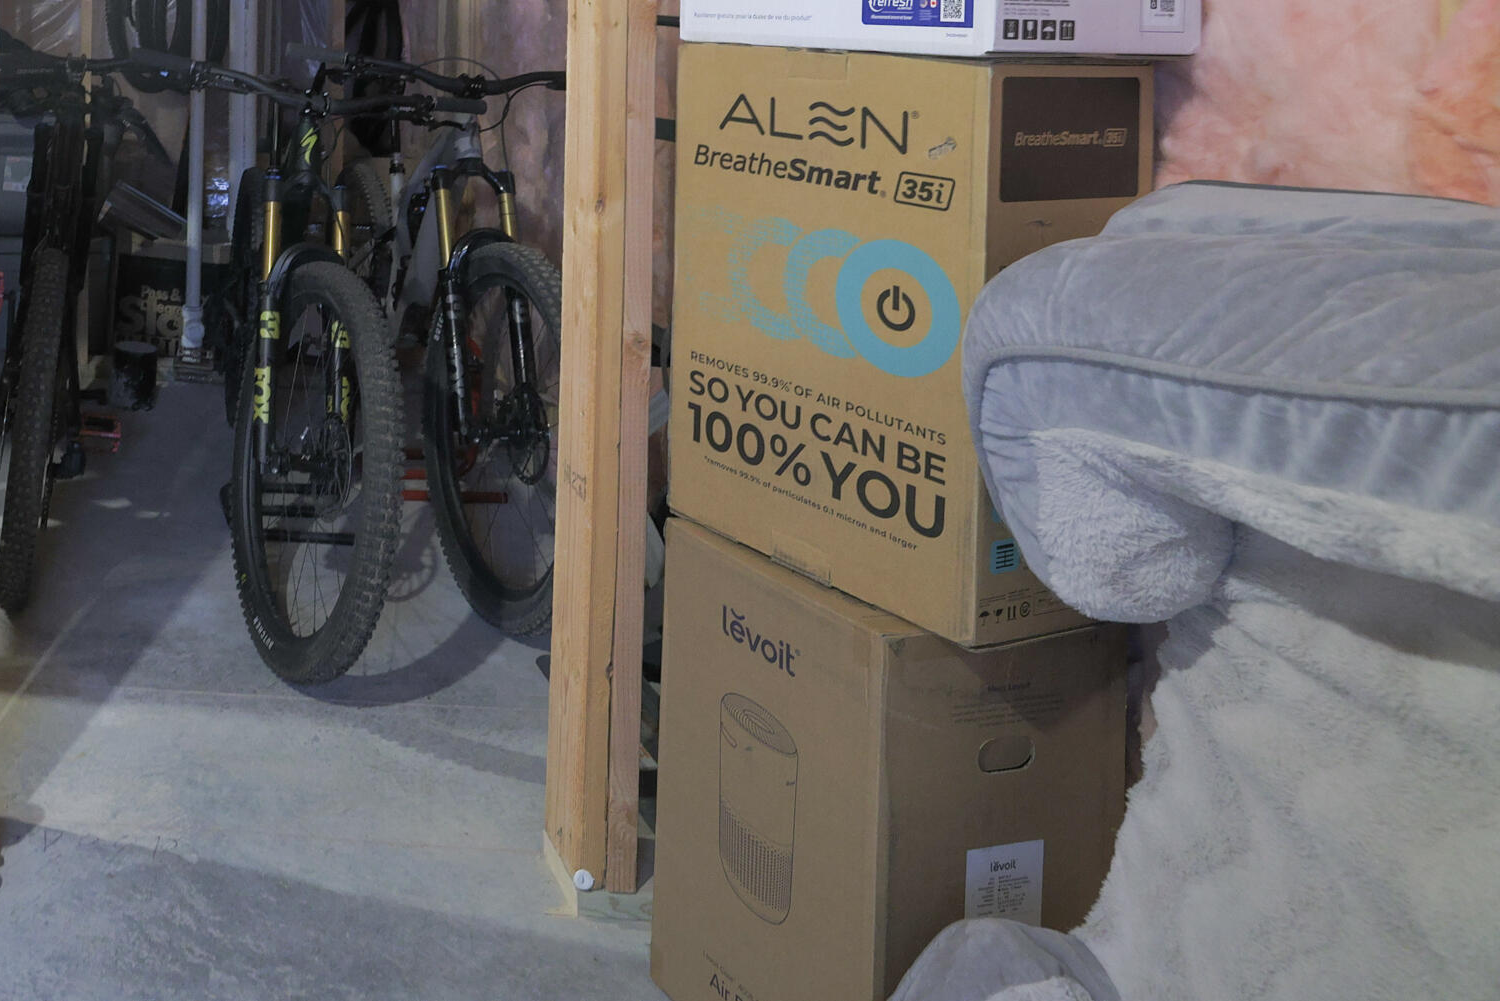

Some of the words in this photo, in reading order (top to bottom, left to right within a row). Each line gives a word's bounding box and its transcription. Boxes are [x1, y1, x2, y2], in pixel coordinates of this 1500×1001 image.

[901, 177, 946, 205] 35i
[254, 366, 272, 424] FOX
[688, 369, 729, 406] SO
[733, 385, 801, 431] YOU
[810, 411, 886, 463] CAN
[897, 440, 947, 487] BE
[690, 350, 750, 379] REMOVES
[794, 383, 813, 399] OF
[816, 391, 841, 411] AIR
[845, 401, 947, 446] POLLUTANTS
[687, 401, 813, 488] 100%
[819, 449, 947, 539] YOU
[738, 468, 762, 486] 99.9%
[762, 477, 772, 489] of
[772, 483, 821, 512] particulates
[822, 504, 835, 517] 0.1
[836, 508, 867, 530] micron
[868, 524, 888, 539] and
[889, 530, 919, 551] larger
